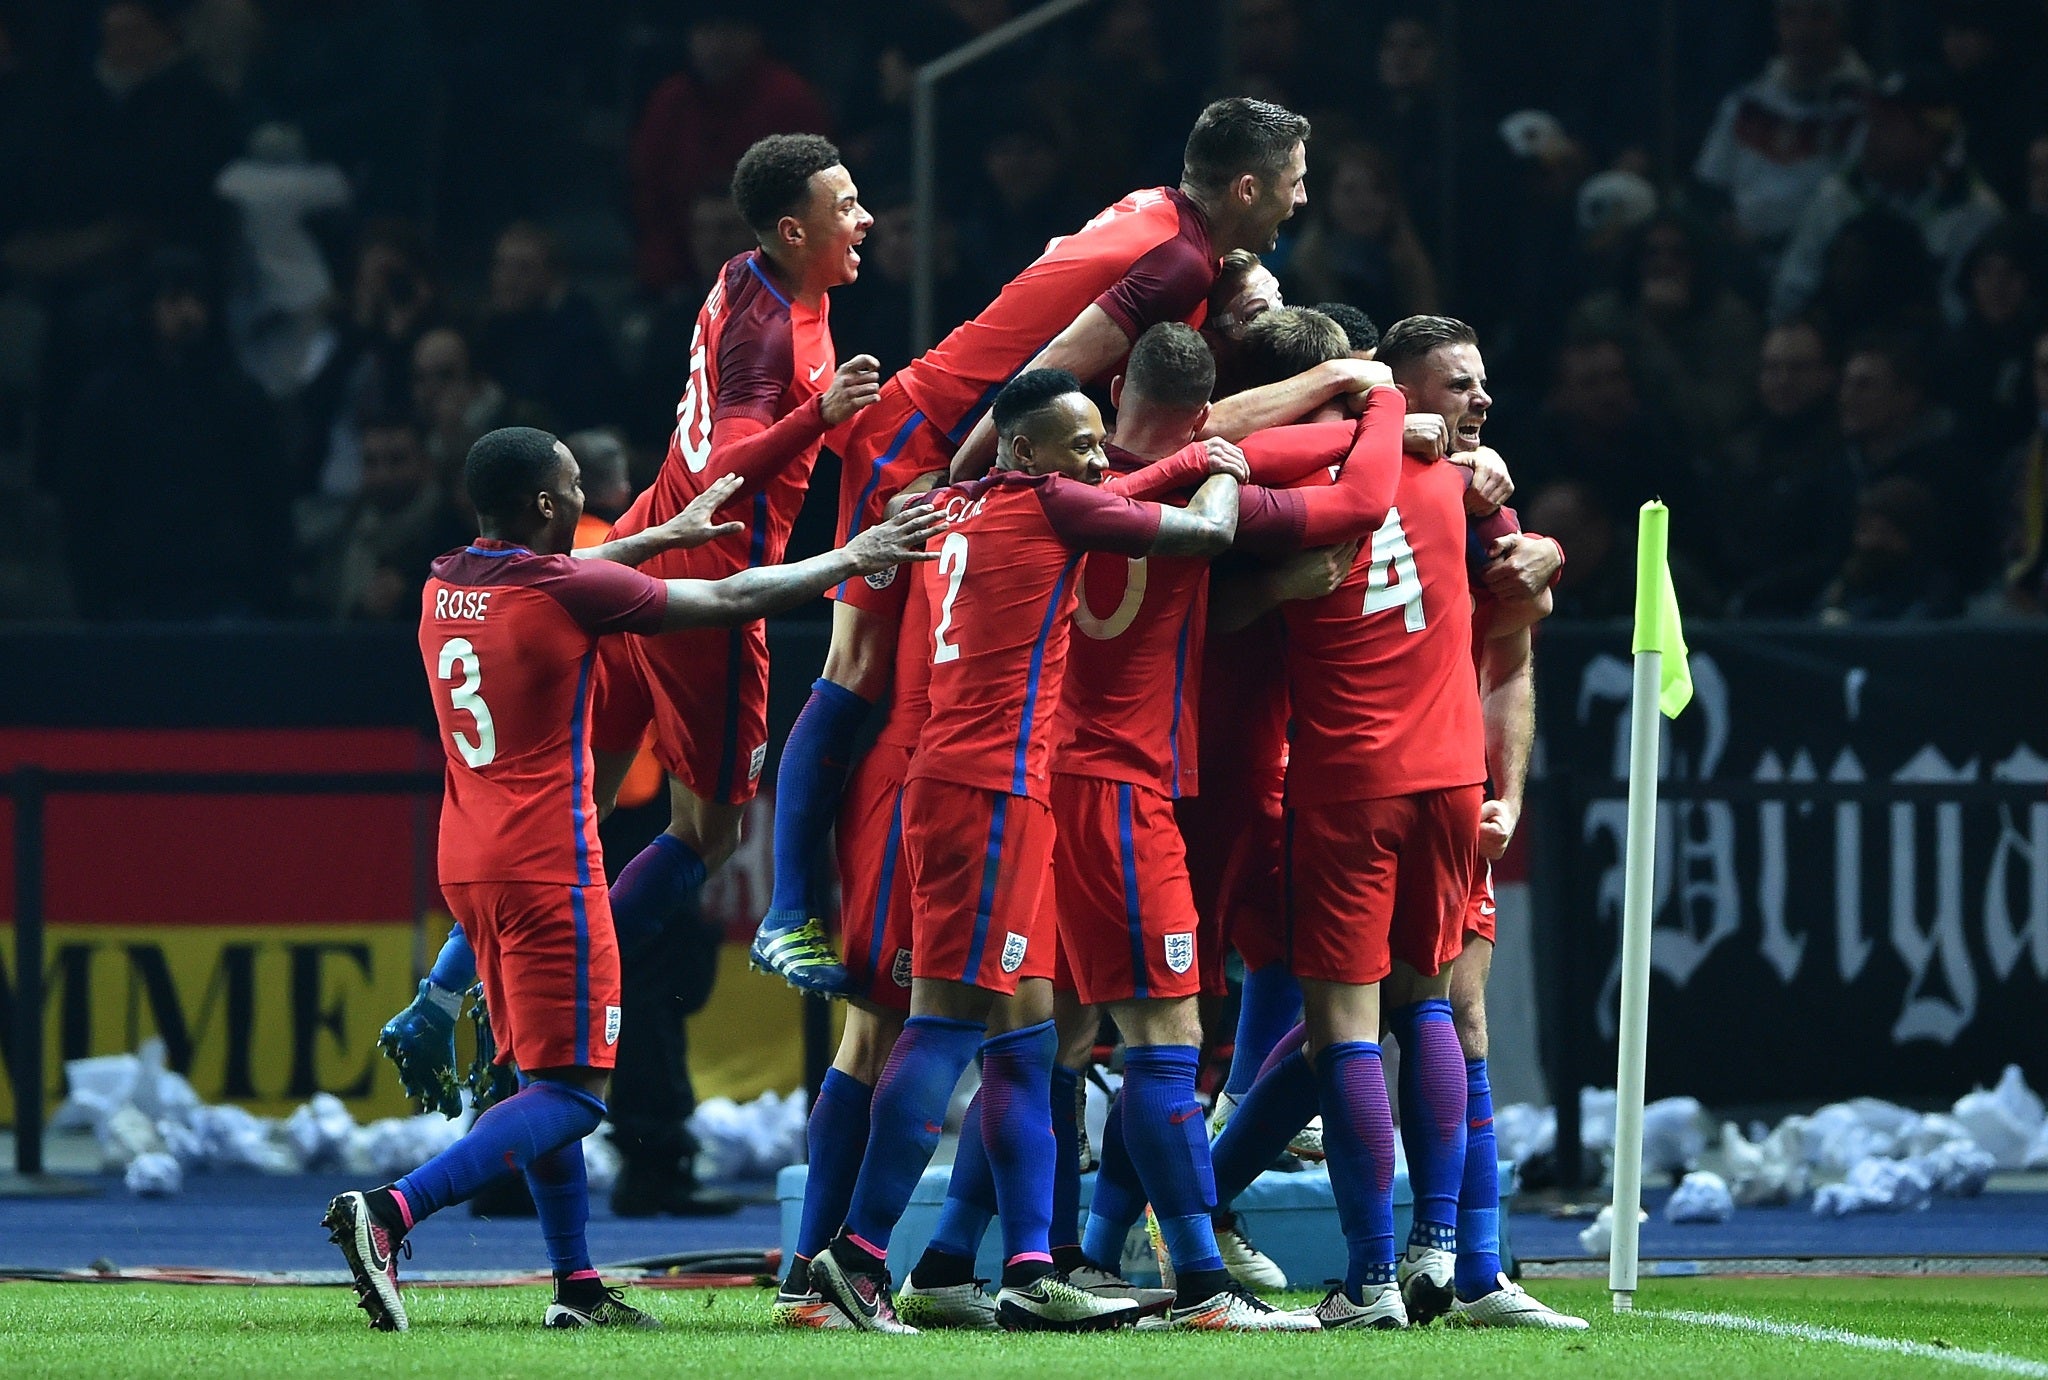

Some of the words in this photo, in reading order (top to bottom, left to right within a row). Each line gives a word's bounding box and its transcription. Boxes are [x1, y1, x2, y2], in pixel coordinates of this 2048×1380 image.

[434, 588, 492, 621] ROSE
[933, 531, 969, 665] 2
[1361, 506, 1427, 634] 4
[437, 637, 496, 769] 3
